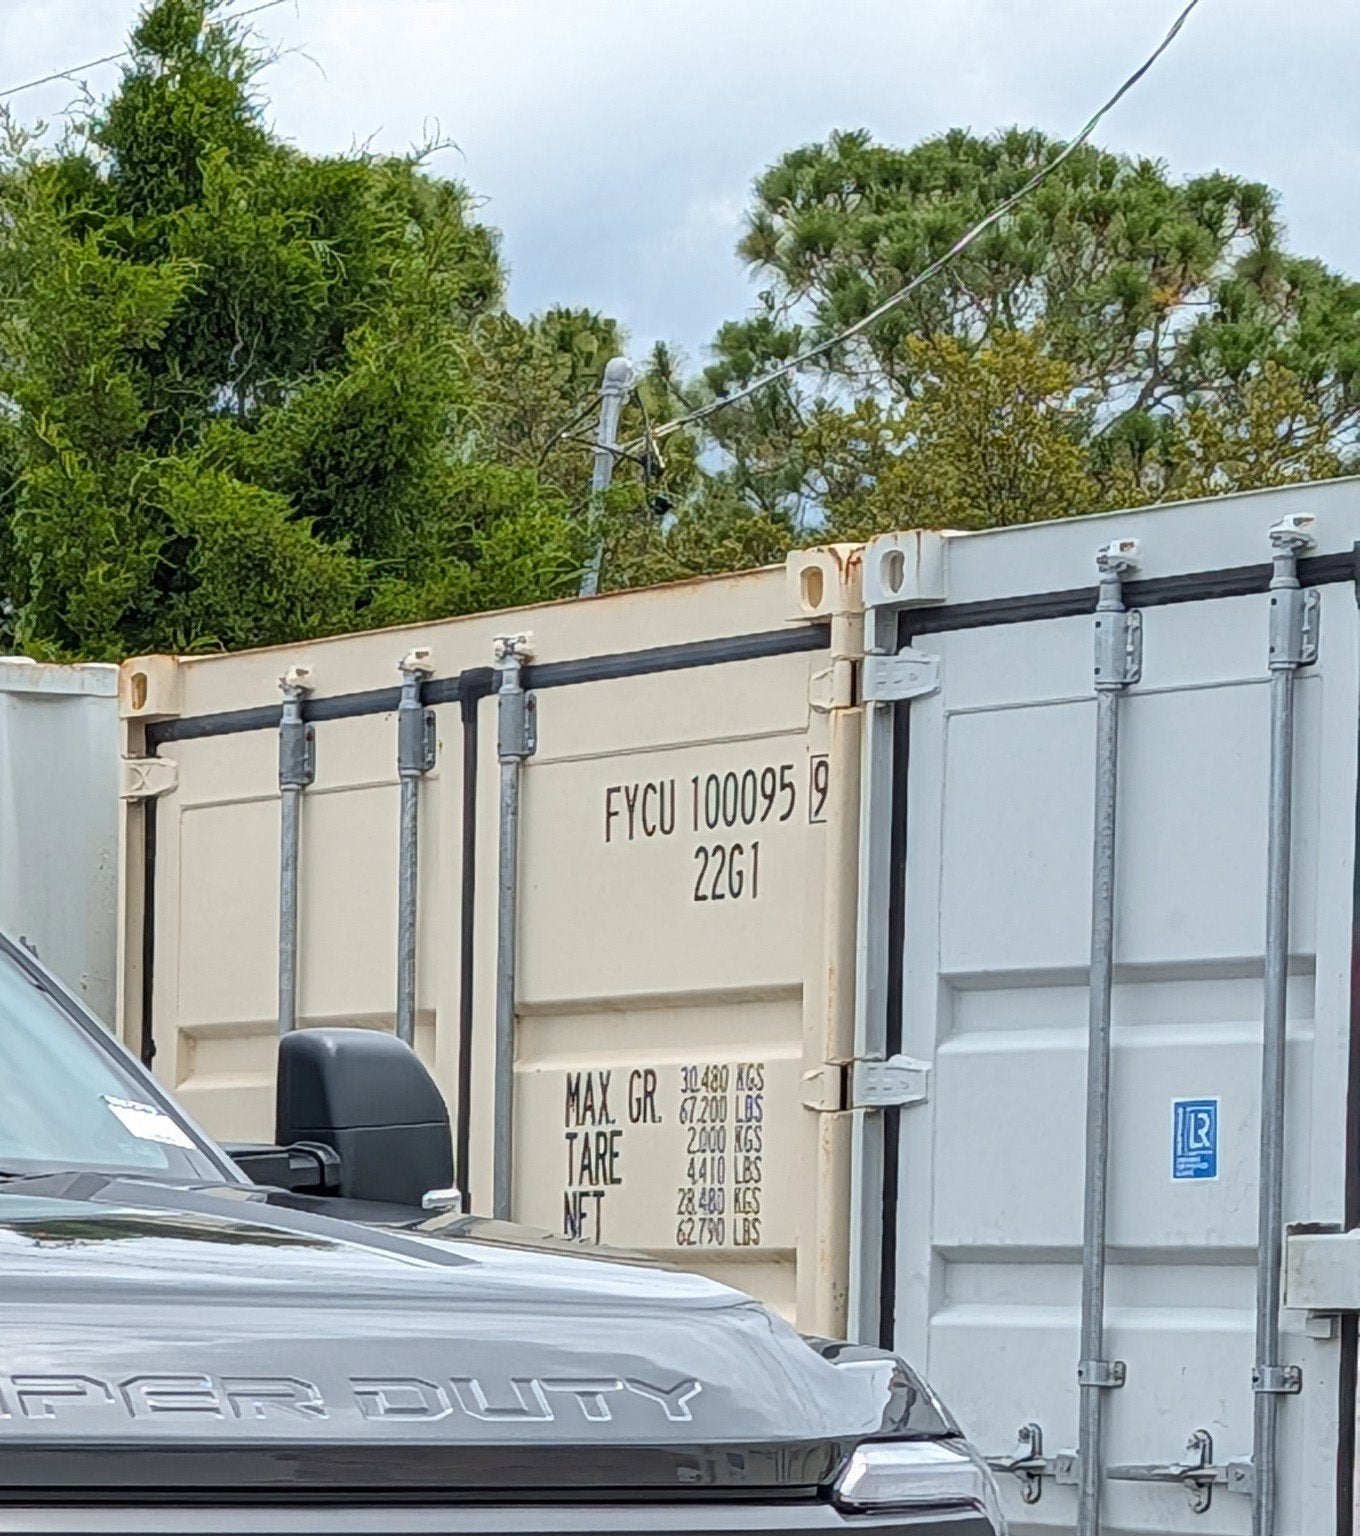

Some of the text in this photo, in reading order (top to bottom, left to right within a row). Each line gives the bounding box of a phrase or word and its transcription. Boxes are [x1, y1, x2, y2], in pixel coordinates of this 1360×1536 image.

[605, 759, 829, 843] FYCU 100095 9
[694, 841, 759, 902] 22G1
[565, 1070, 616, 1127] MAX.
[629, 1068, 663, 1124] GR.
[736, 1062, 765, 1092] KGS
[735, 1093, 764, 1123] LBS
[734, 1124, 763, 1153] KGS
[565, 1130, 623, 1187] TARE
[734, 1155, 762, 1184] LBS
[734, 1186, 762, 1215] KGS
[733, 1217, 762, 1246] LBS
[348, 1375, 703, 1422] DUTY
